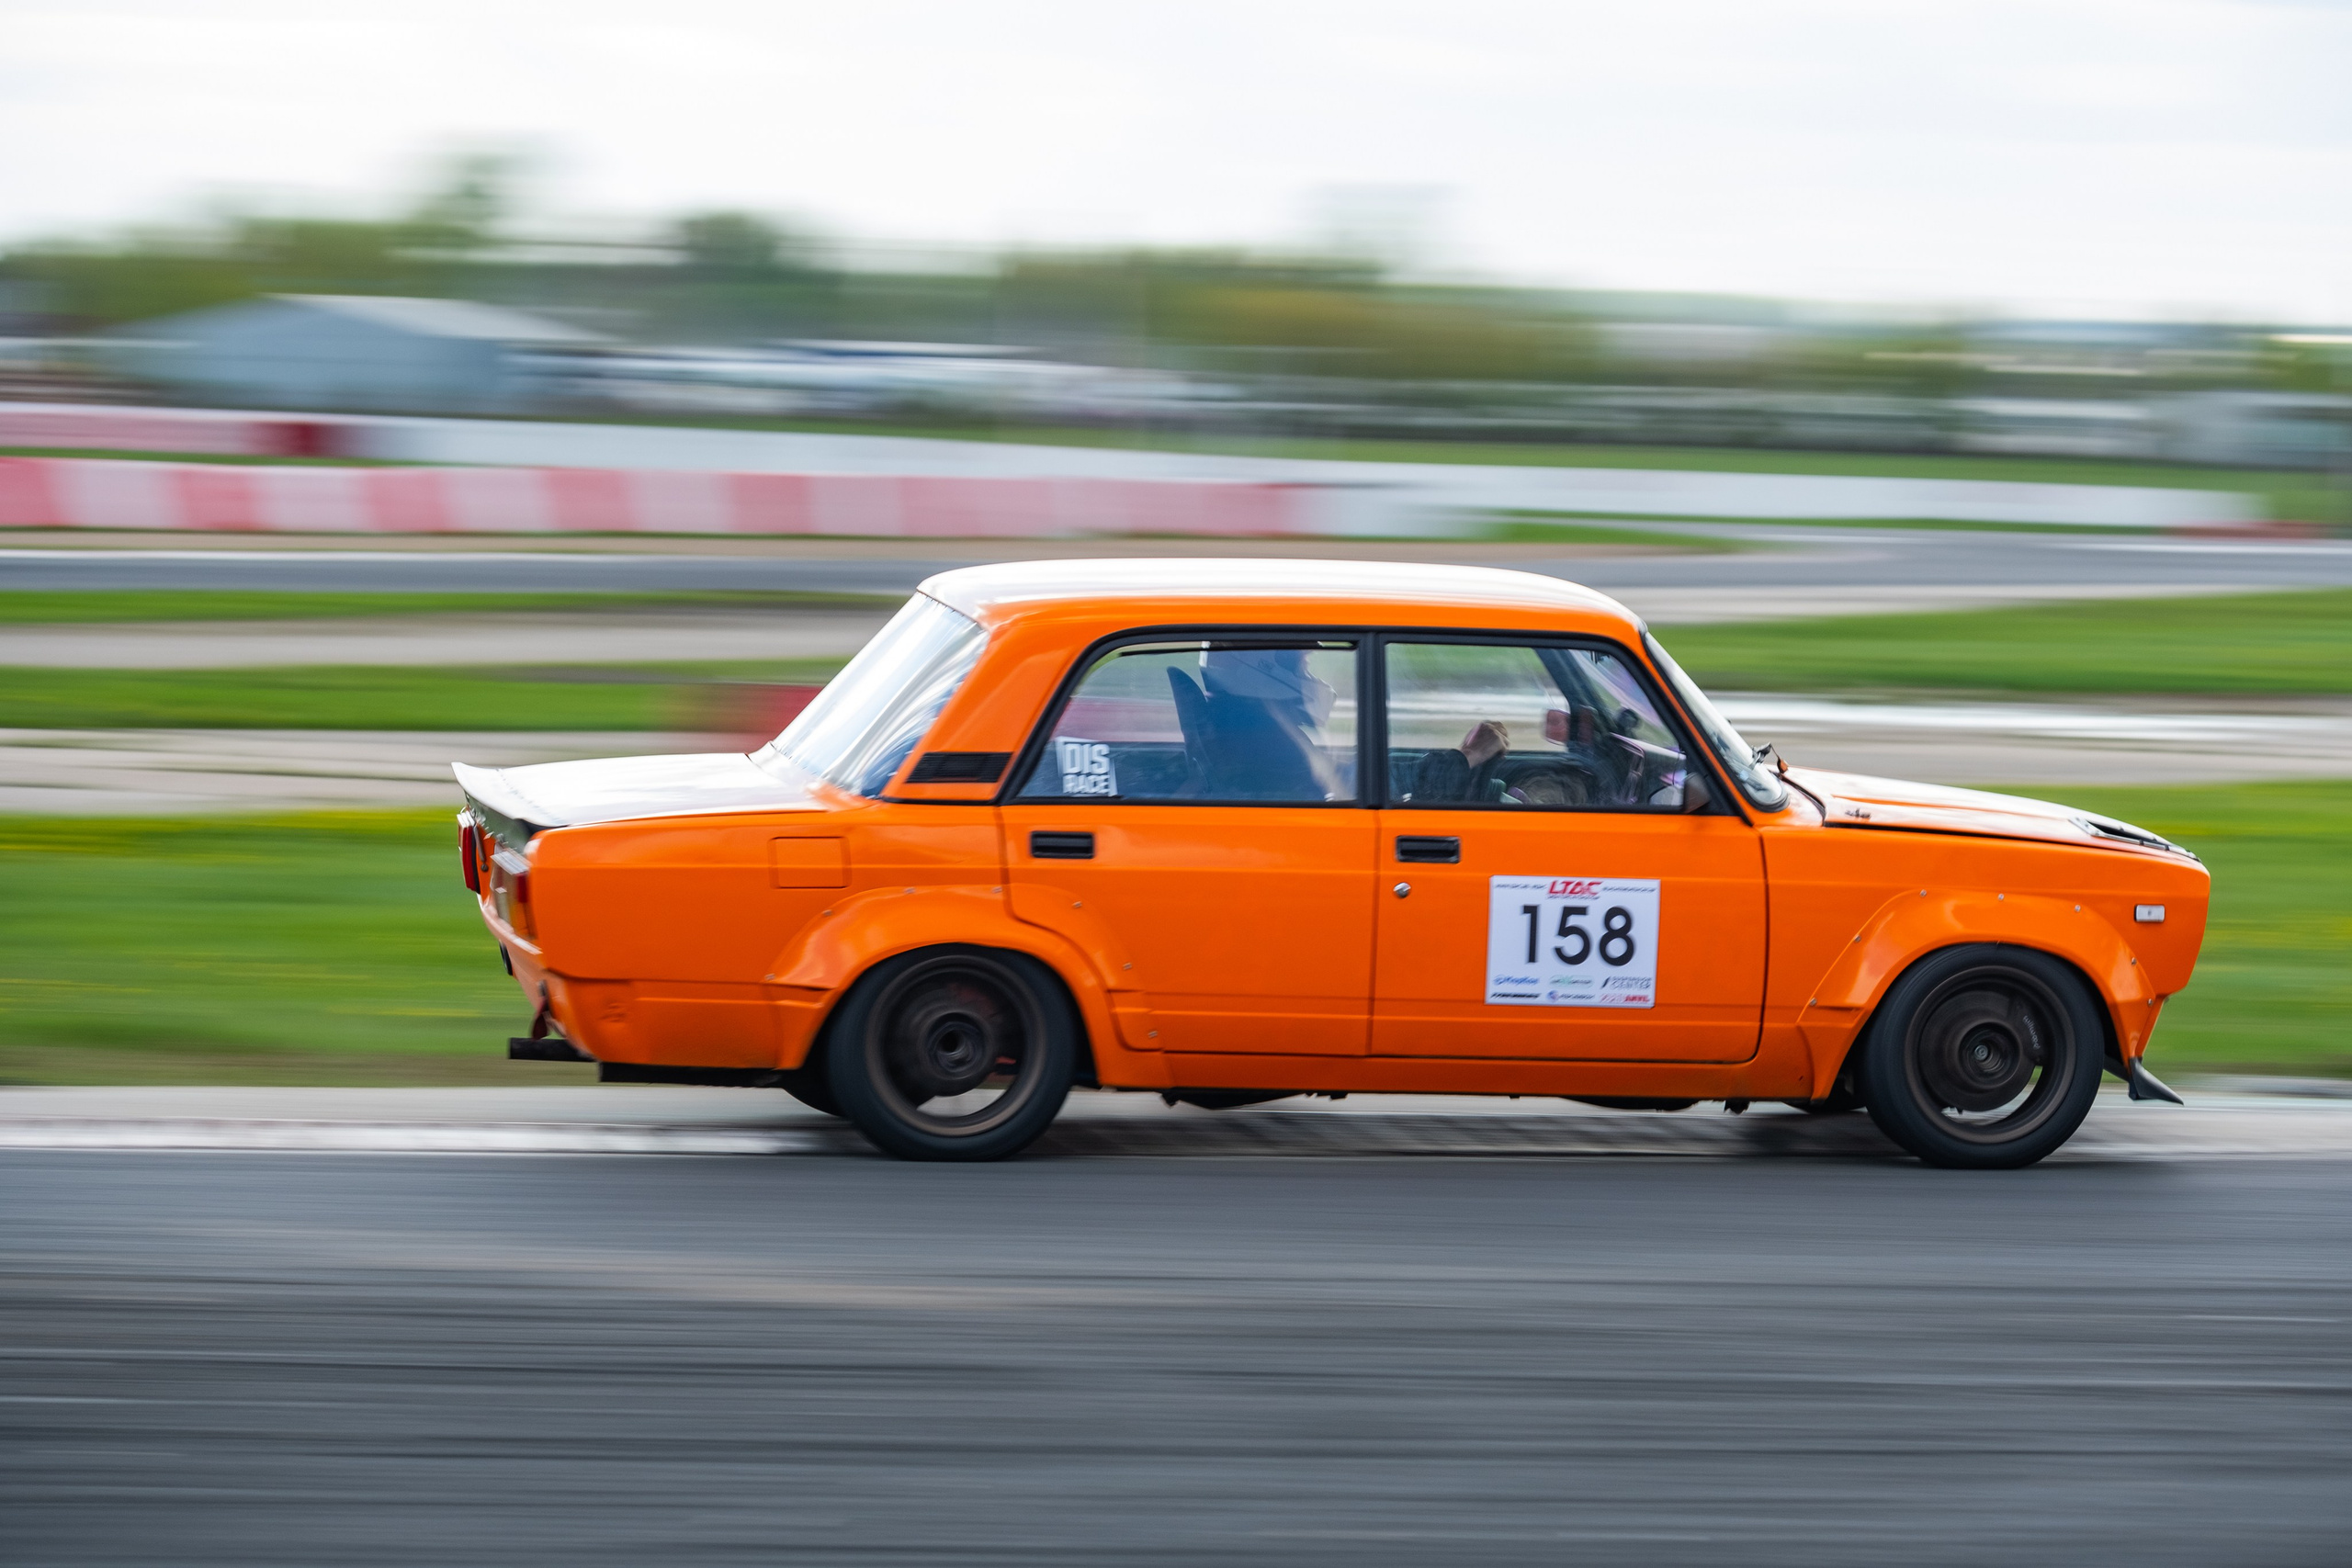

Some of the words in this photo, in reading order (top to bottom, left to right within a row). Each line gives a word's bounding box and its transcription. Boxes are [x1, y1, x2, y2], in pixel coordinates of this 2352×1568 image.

[1063, 743, 1110, 774] DIS
[1063, 774, 1110, 794] RACE
[1521, 904, 1635, 966] 158
[2022, 1015, 2041, 1050] wilwood
